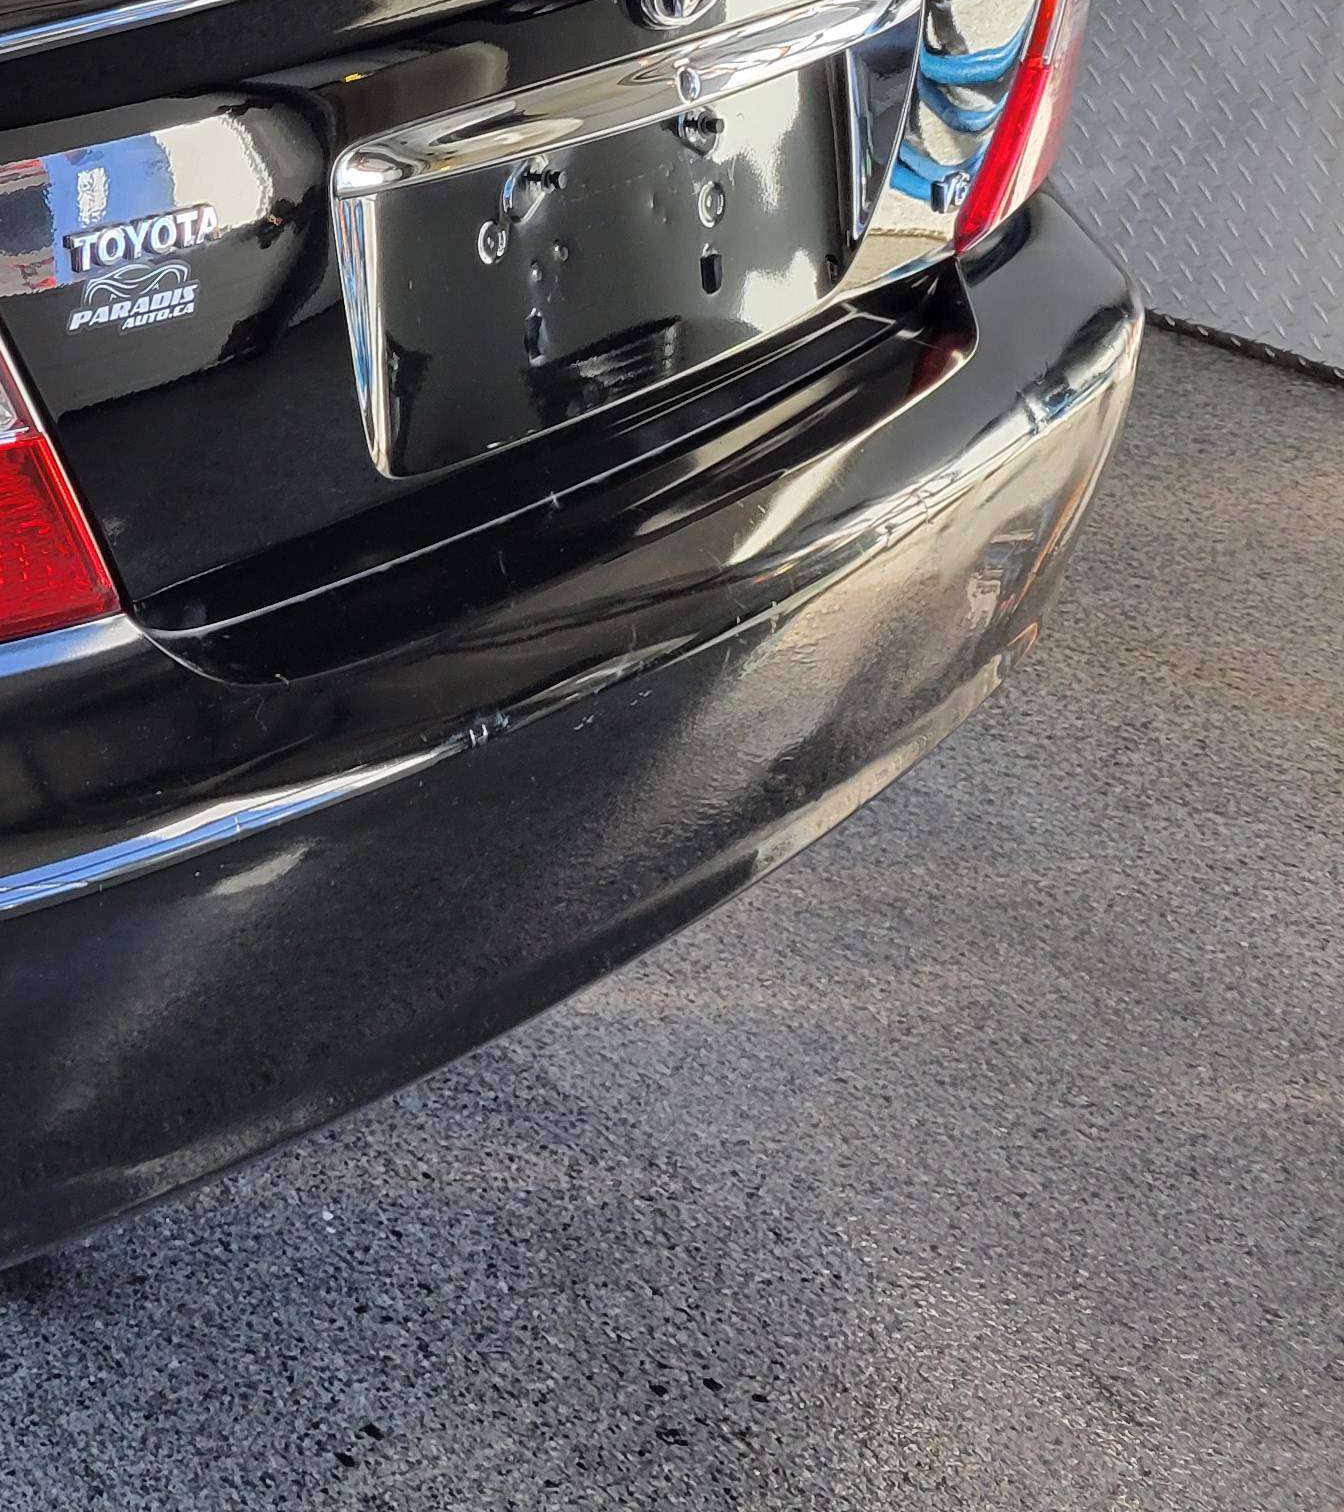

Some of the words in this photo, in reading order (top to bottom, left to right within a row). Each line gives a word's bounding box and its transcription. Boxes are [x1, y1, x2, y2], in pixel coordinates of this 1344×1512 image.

[64, 203, 219, 273] TOYOTA
[68, 284, 199, 331] PARADIS
[121, 302, 195, 330] AUTO.CA
